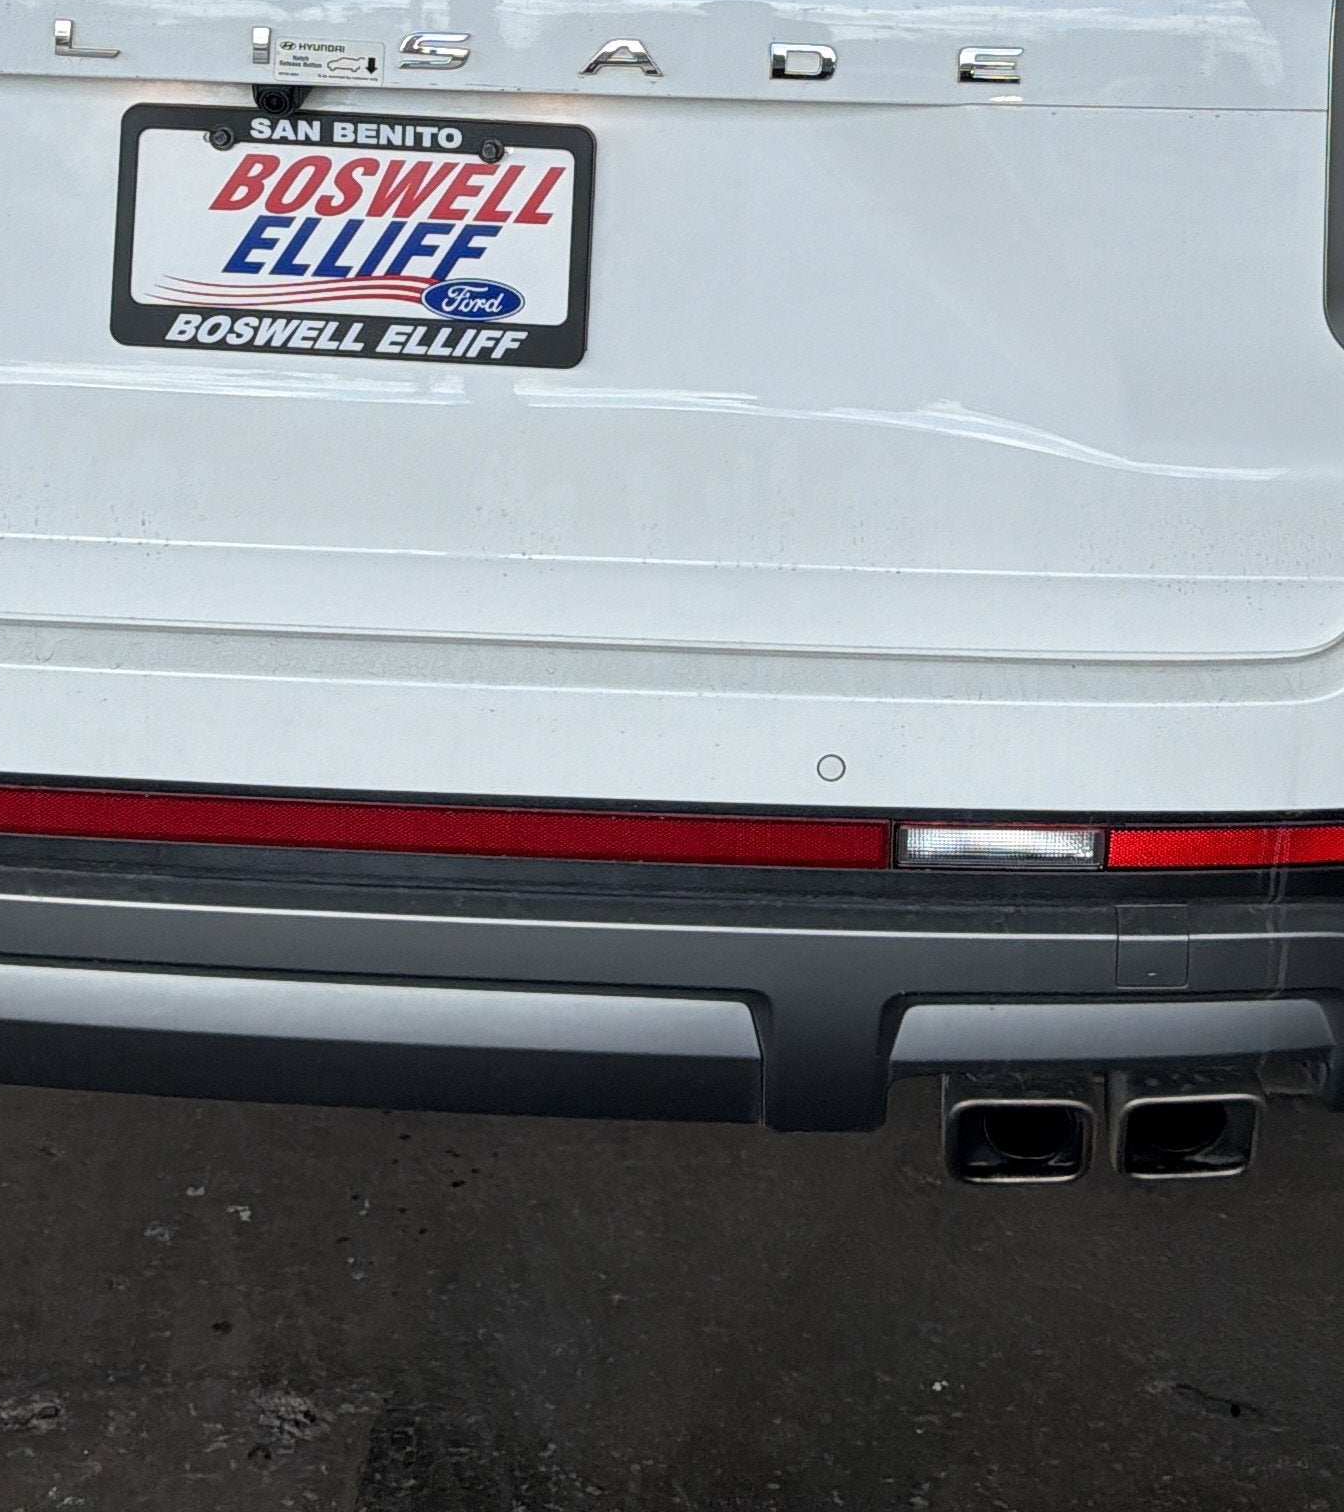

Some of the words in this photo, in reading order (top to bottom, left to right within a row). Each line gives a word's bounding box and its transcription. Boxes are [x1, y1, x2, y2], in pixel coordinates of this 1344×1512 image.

[299, 42, 346, 53] HYUNDAI
[250, 118, 322, 142] SAN
[333, 122, 463, 149] BENITO
[208, 153, 566, 225] BOSWELL
[221, 215, 503, 281] ELLIFF
[441, 287, 503, 314] Ford
[166, 314, 365, 352] BOSWELL
[375, 325, 528, 359] ELLIFF
